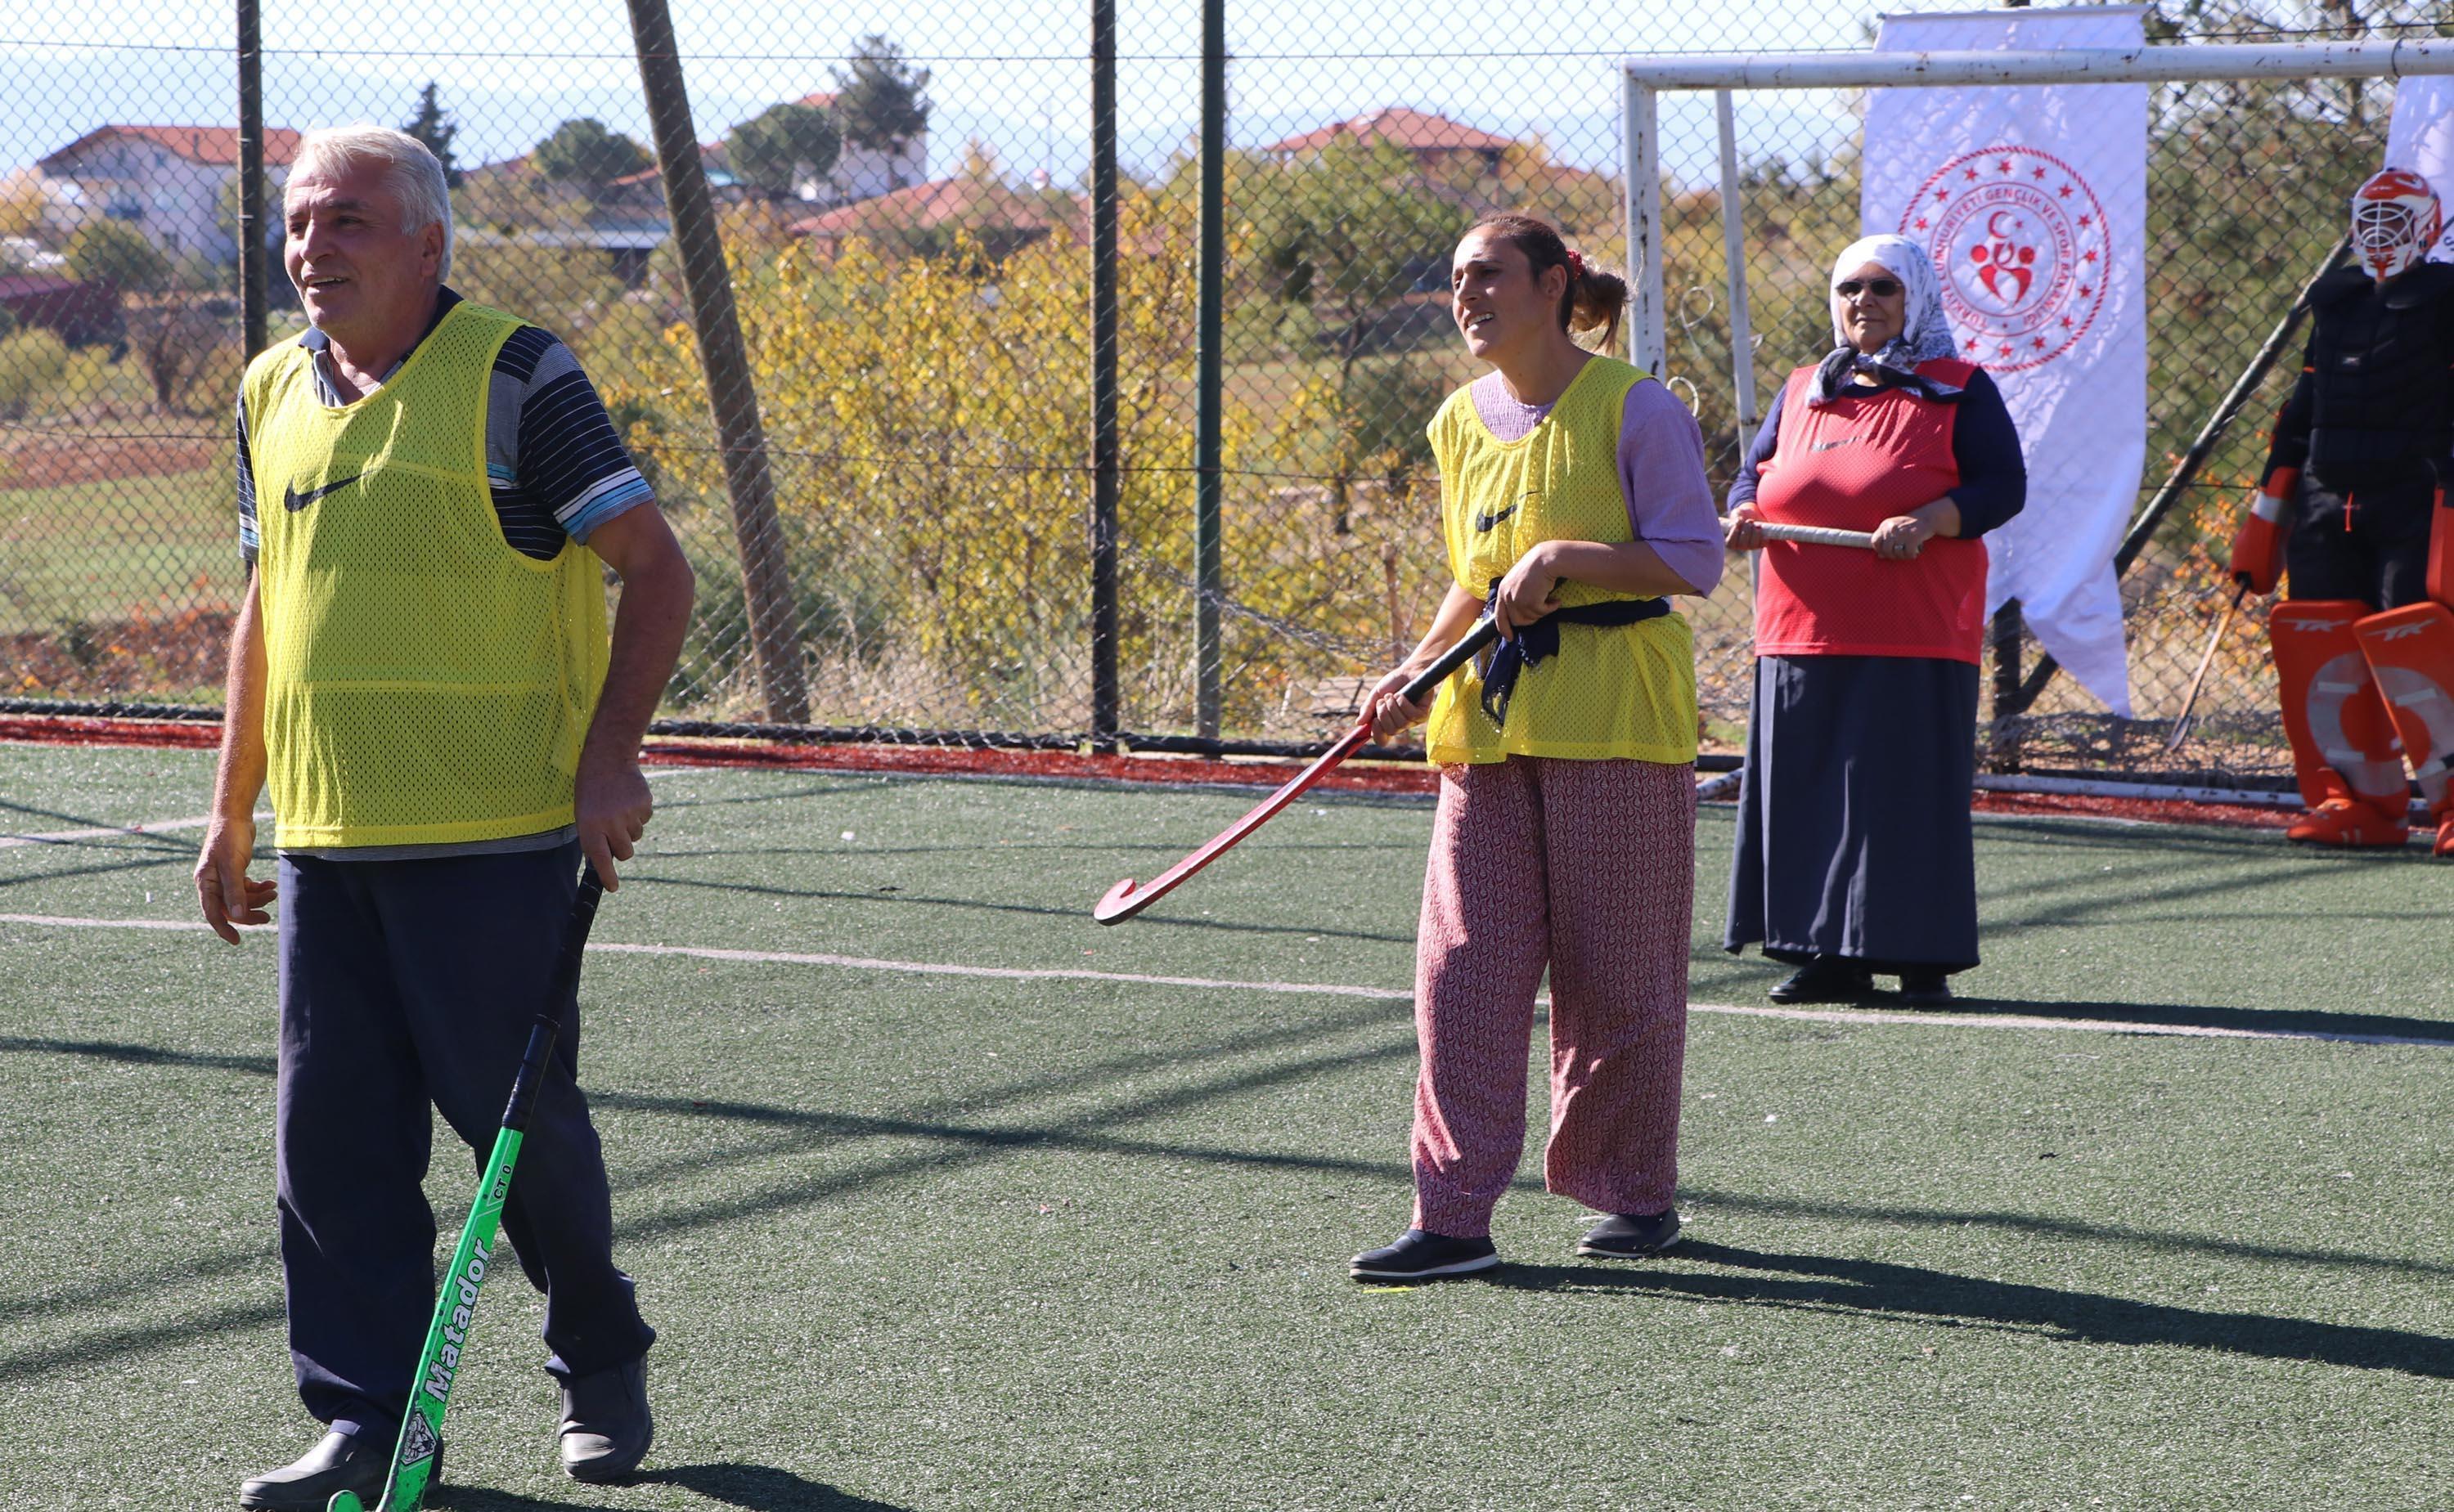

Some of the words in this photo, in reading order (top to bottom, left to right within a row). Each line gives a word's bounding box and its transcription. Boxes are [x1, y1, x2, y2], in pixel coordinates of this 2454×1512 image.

[1985, 187, 2041, 204] GENÇLİK
[2043, 203, 2057, 220] VE
[1934, 192, 1983, 281] CUMHURİYETİ
[2055, 222, 2071, 258] SPOR
[1940, 285, 1988, 329] TÜRKİYE
[2024, 262, 2070, 325] BAKANLIĞI
[494, 1178, 506, 1200] CT
[424, 1237, 491, 1403] Matador
